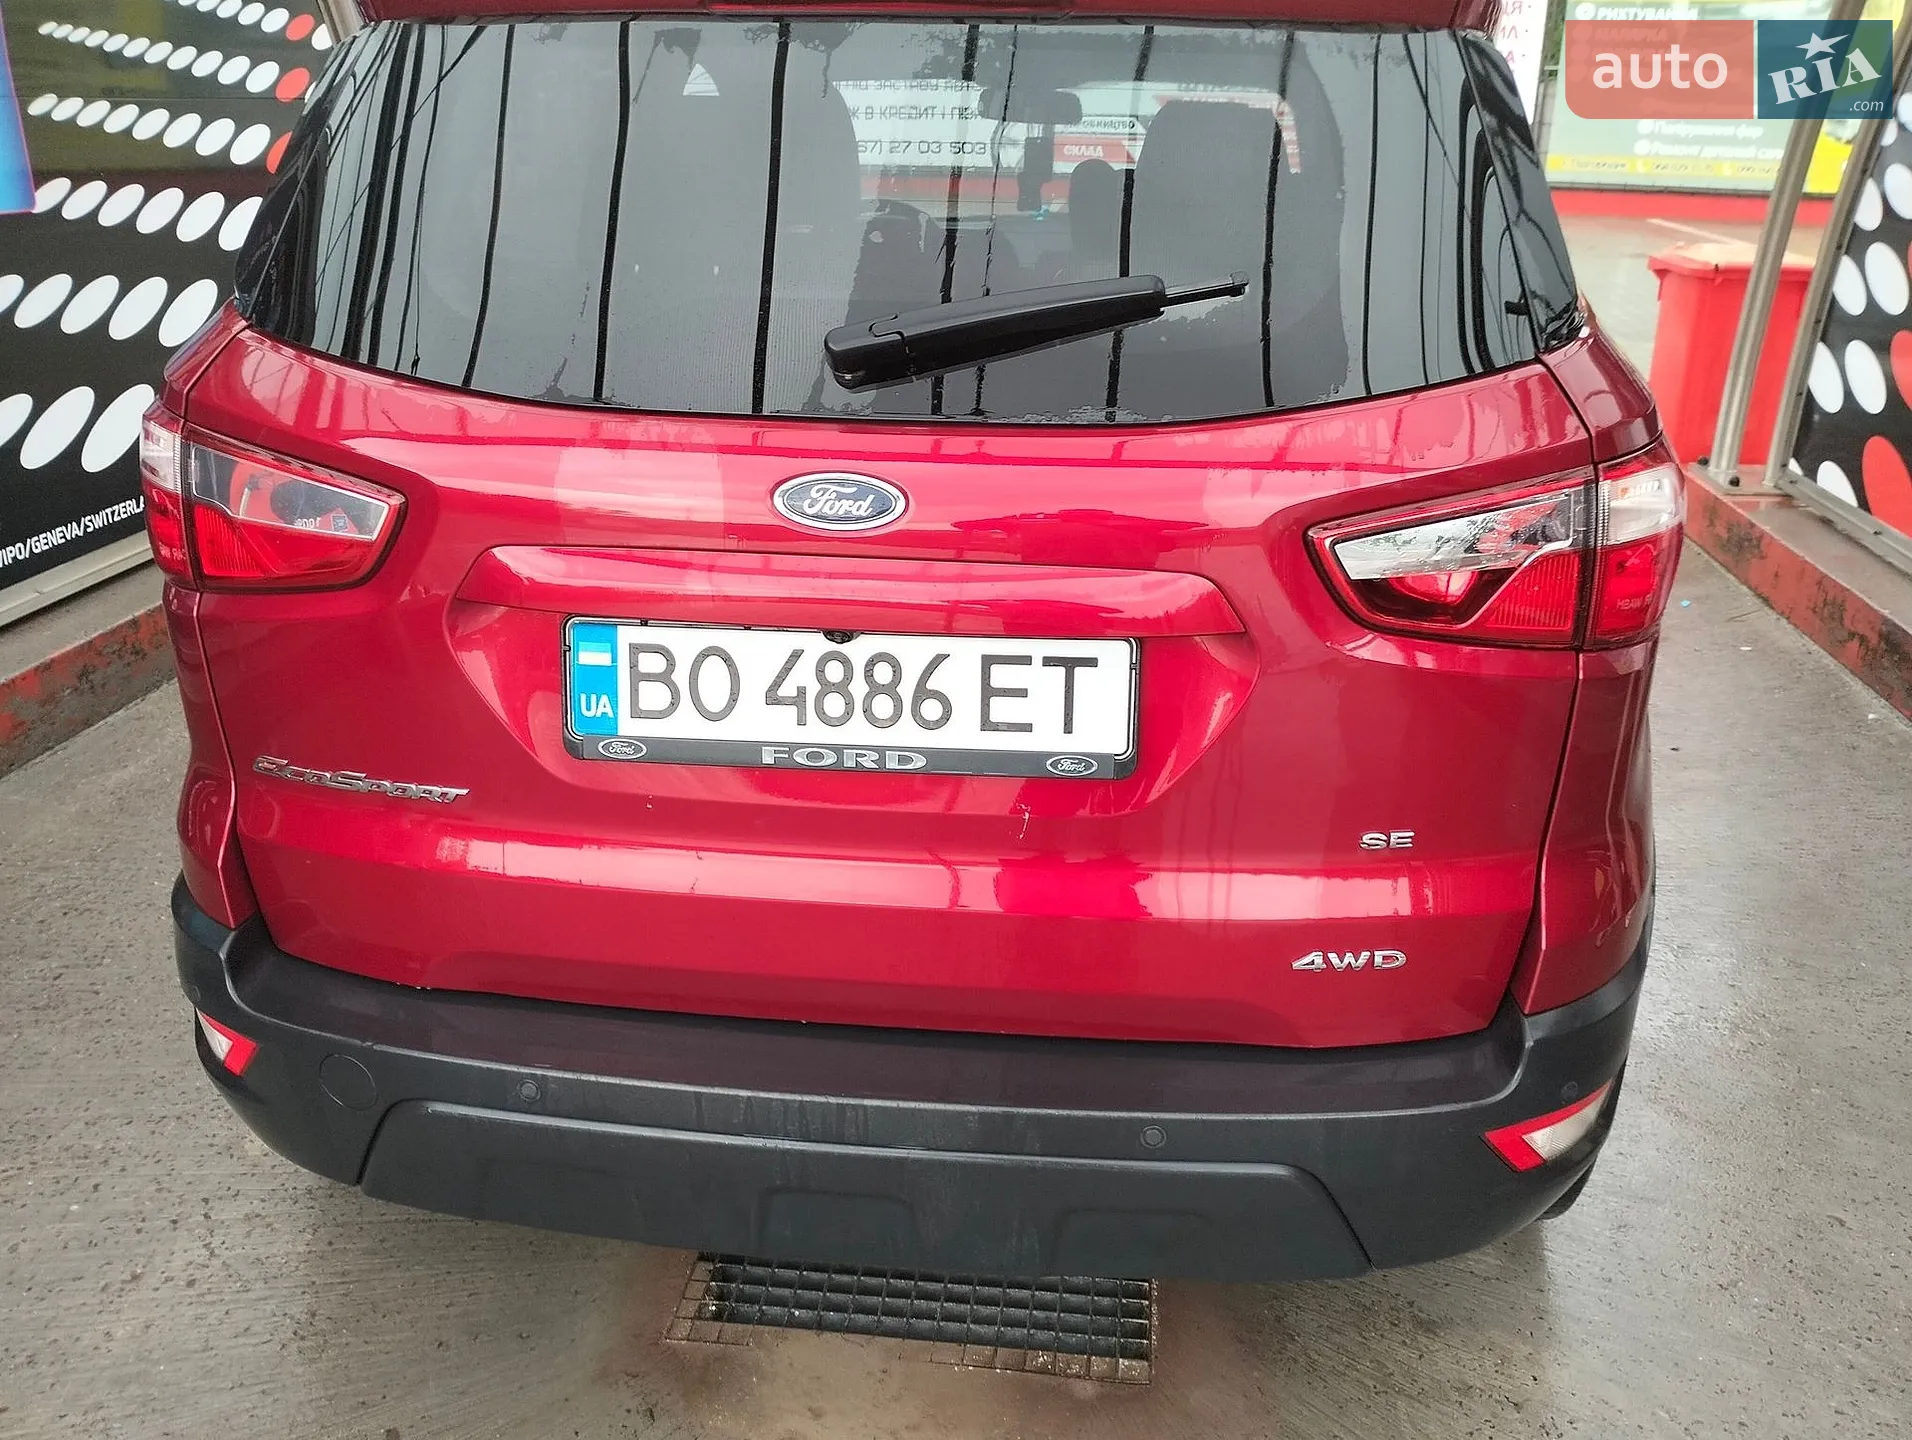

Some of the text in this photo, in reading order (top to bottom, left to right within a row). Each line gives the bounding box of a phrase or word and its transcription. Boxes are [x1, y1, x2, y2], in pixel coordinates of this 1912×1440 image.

[889, 140, 913, 155] 27
[803, 484, 875, 517] Ford
[628, 643, 1099, 735] BO 4886 ET
[580, 692, 614, 719] UA
[608, 740, 637, 757] Ford
[760, 745, 928, 771] FORD
[1056, 757, 1087, 774] Ford
[1360, 829, 1415, 850] SE
[1291, 949, 1407, 973] 4WD
